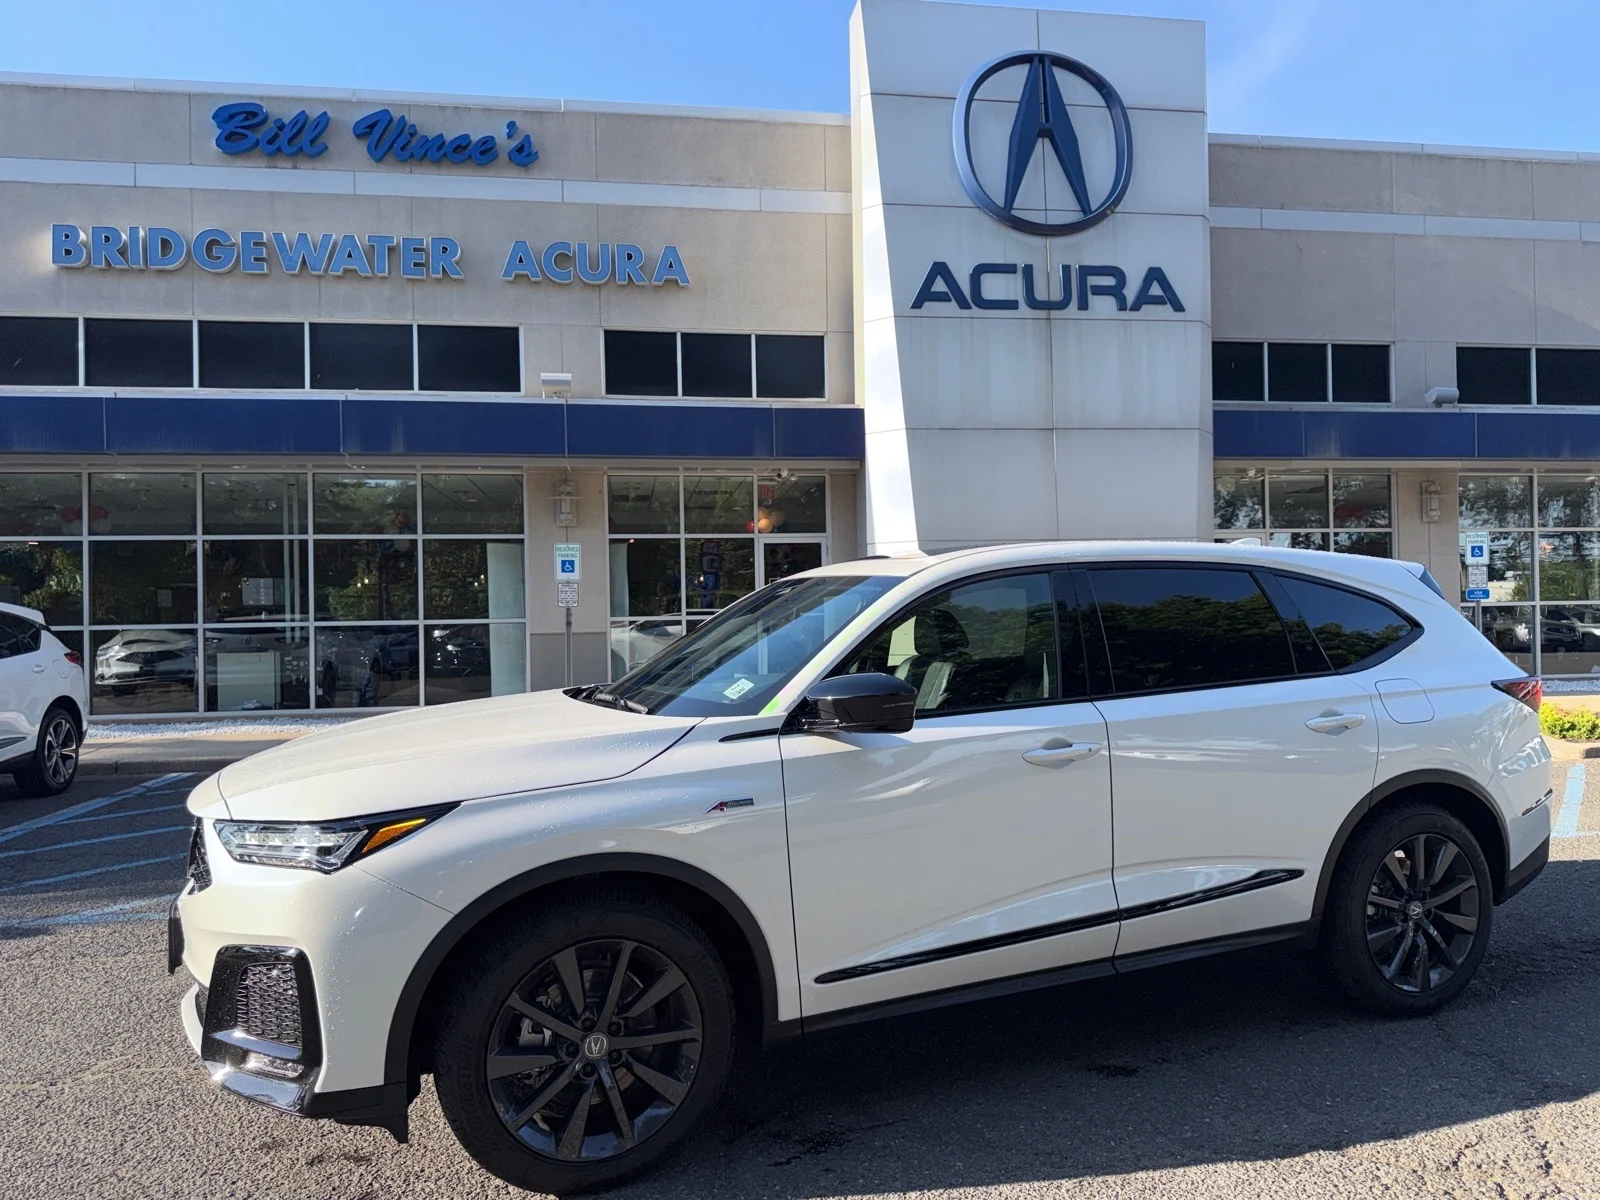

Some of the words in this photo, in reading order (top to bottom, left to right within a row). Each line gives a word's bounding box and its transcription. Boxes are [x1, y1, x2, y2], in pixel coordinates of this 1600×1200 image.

[211, 102, 330, 157] Bill
[353, 108, 539, 168] Vince's
[51, 223, 465, 280] BRIDGEWATER
[501, 240, 692, 287] ACURA
[909, 261, 1186, 312] ACURA
